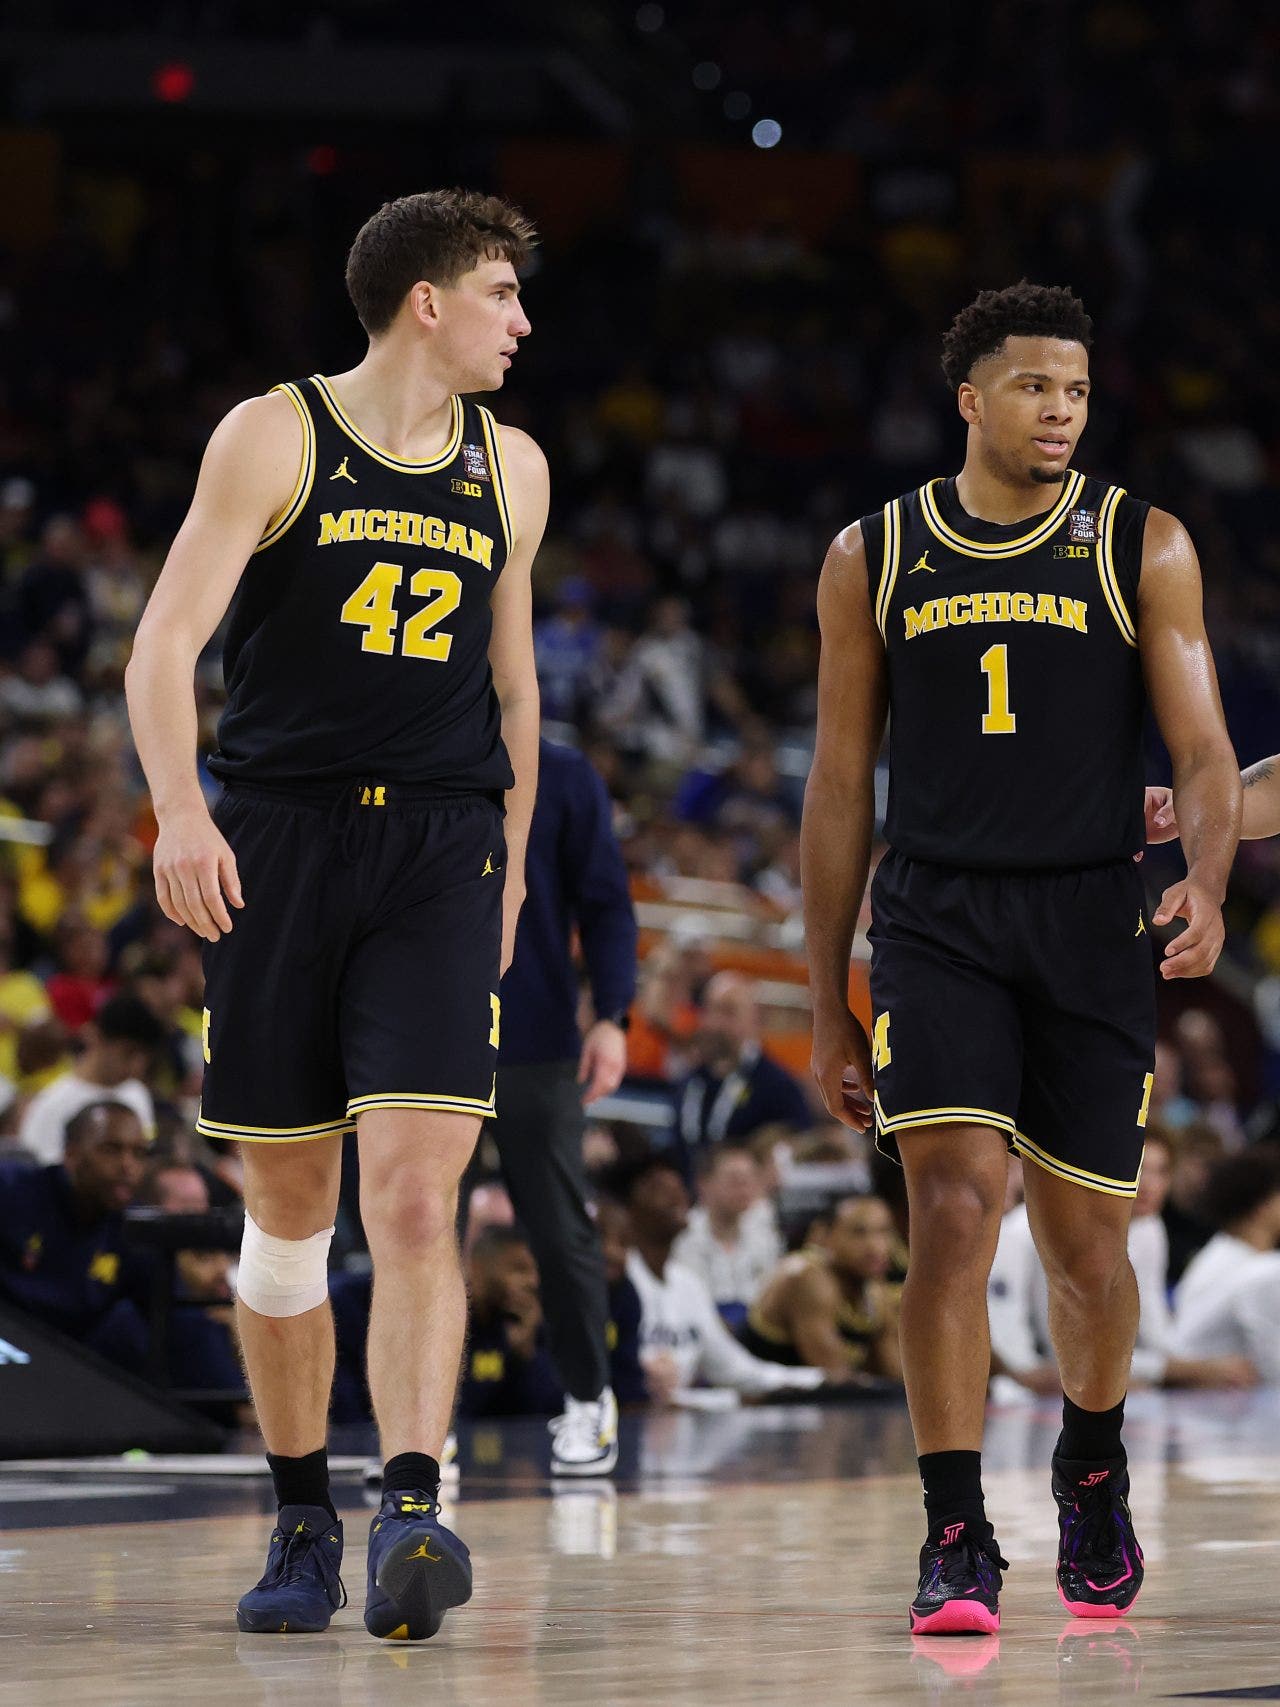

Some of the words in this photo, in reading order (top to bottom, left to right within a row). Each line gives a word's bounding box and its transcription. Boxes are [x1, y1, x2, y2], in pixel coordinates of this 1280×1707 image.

[463, 450, 484, 460] FINAL
[467, 465, 487, 475] FOUR
[1071, 514, 1095, 524] FINAL
[1072, 528, 1095, 538] FOUR
[317, 508, 494, 571] MICHIGAN
[340, 561, 463, 662] 42
[903, 592, 1088, 641] MICHIGAN
[980, 643, 1016, 734] 1
